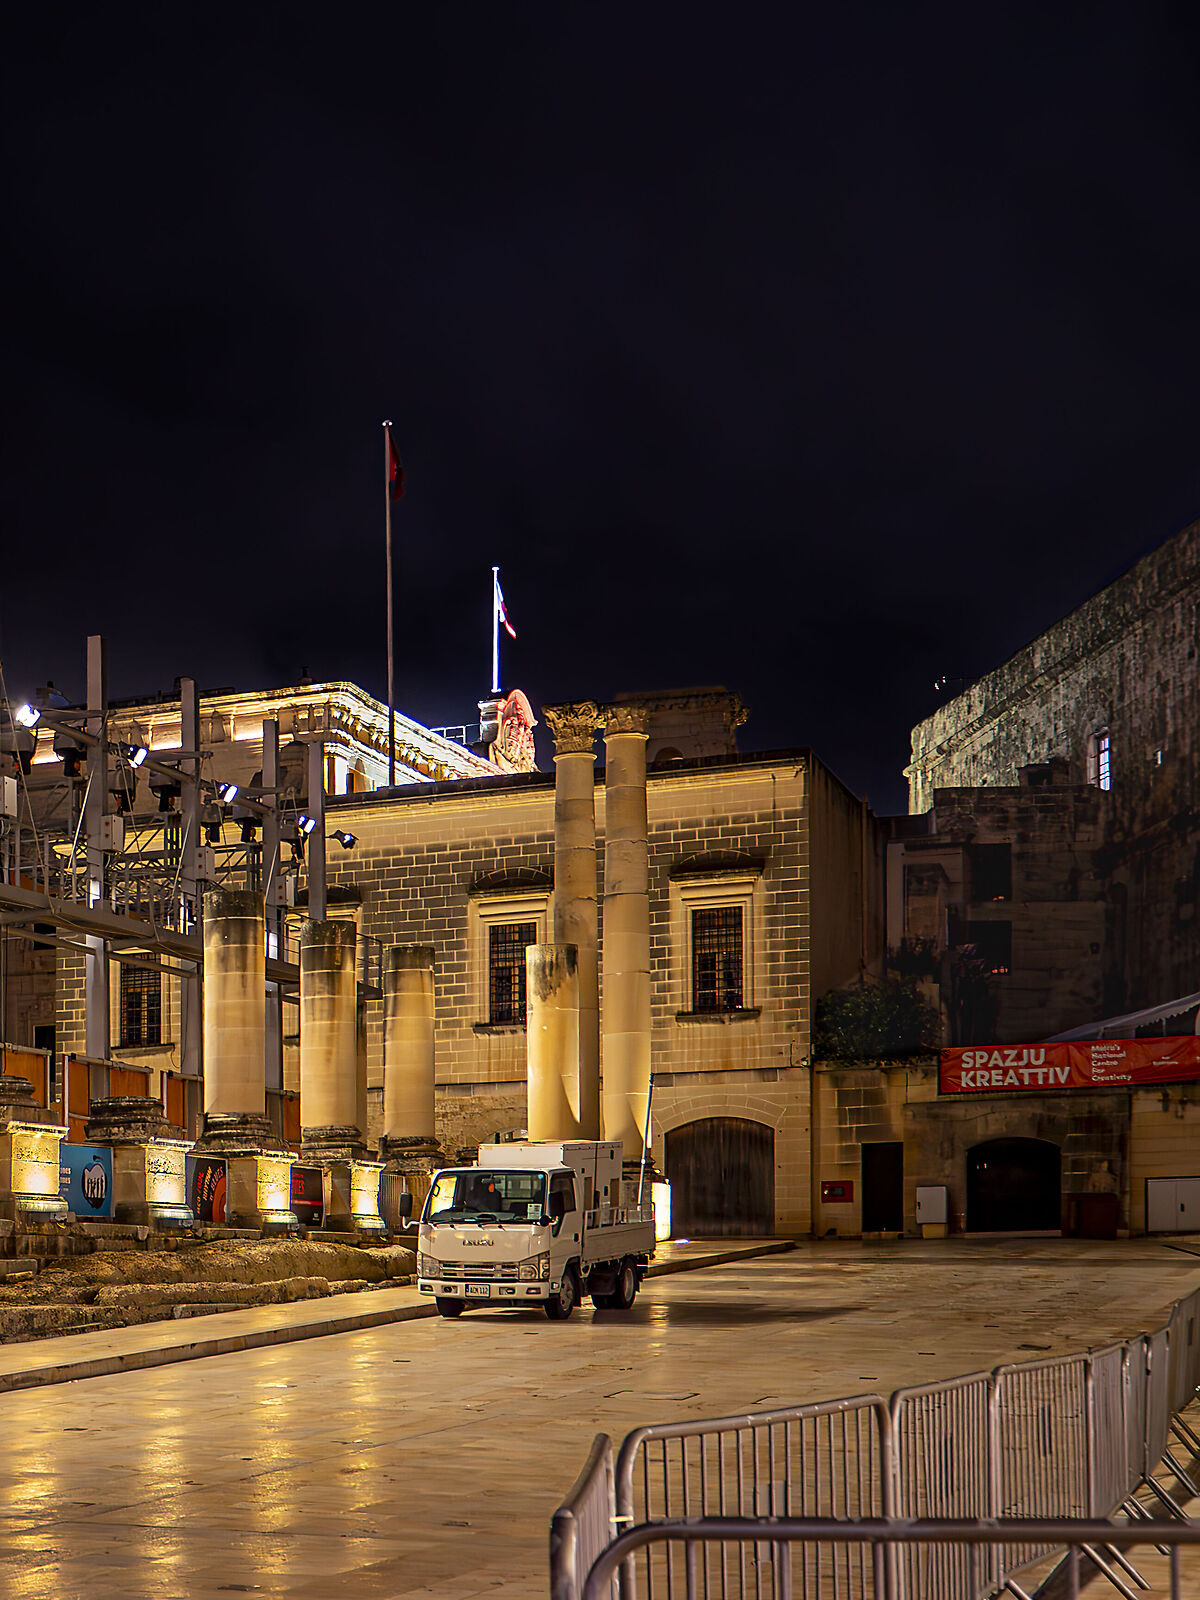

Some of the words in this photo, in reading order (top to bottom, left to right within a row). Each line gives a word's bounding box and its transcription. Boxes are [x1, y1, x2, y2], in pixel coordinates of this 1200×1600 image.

[961, 1048, 1046, 1068] SPAZJU
[1091, 1051, 1127, 1059] National
[961, 1067, 1071, 1088] KREATTIV
[197, 1171, 205, 1194] SOUL
[462, 1239, 494, 1247] ISUZU
